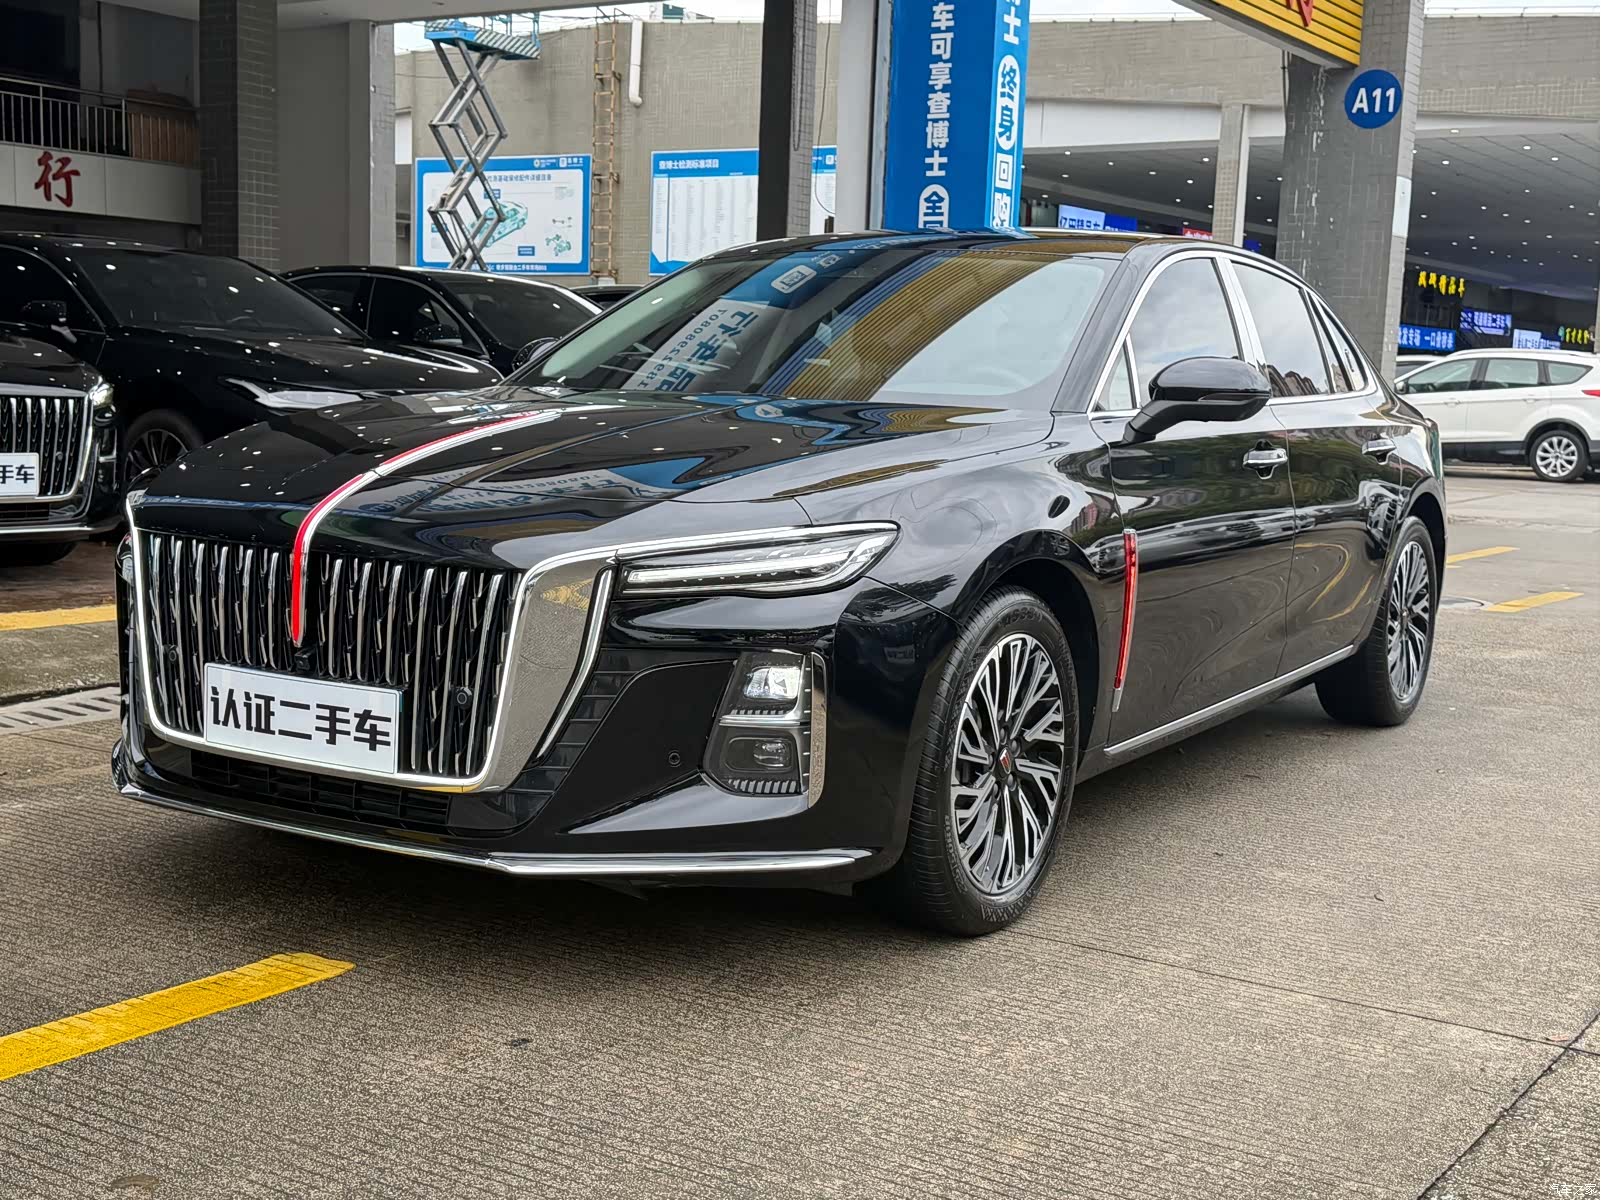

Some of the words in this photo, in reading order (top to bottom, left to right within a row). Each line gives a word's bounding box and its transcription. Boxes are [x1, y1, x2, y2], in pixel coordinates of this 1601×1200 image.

[1001, 0, 1022, 45] 士
[925, 2, 955, 177] 车可享查博士
[1352, 88, 1395, 114] A11
[34, 151, 81, 208] 行
[210, 686, 392, 752] 认证二手车
